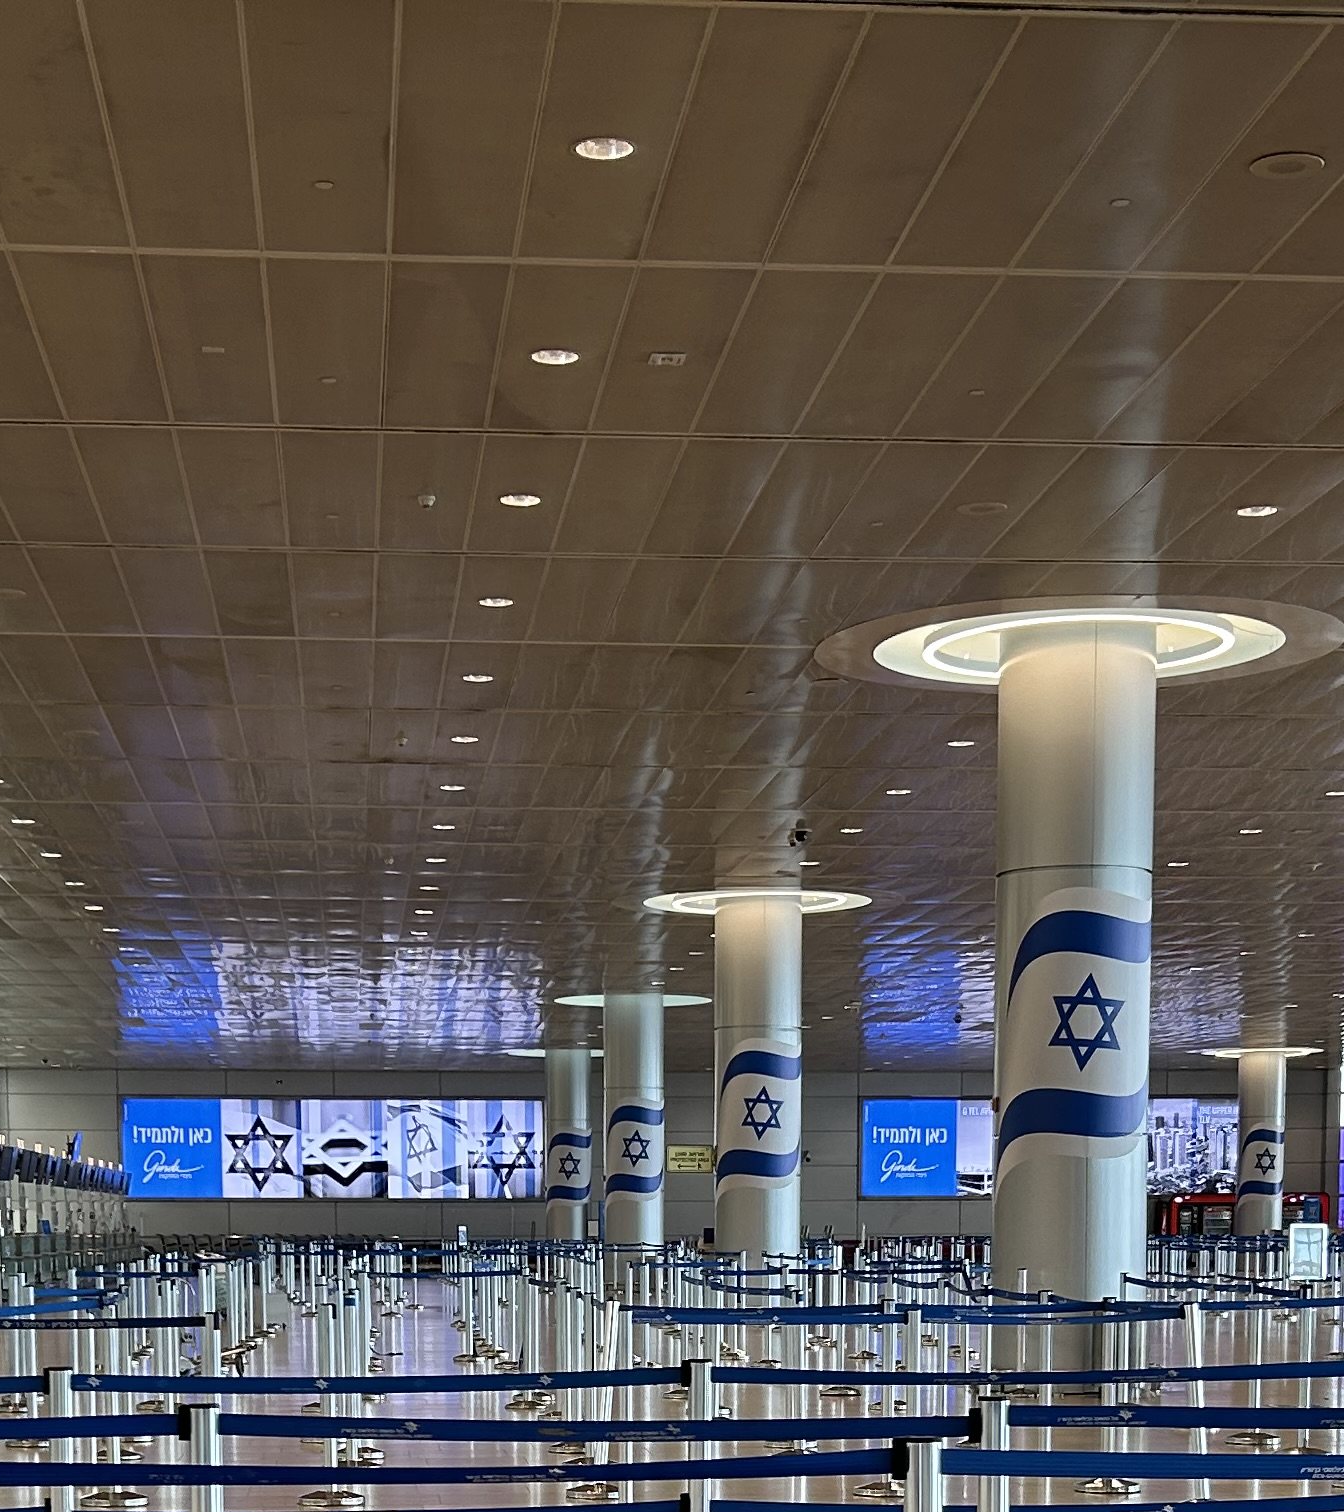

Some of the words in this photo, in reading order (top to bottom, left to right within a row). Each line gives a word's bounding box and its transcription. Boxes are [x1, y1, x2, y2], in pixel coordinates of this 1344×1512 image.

[133, 1125, 184, 1143] ולתמיד!
[189, 1128, 212, 1146] כאן
[873, 1126, 921, 1144] ולתמיד!
[926, 1128, 947, 1146] כאן
